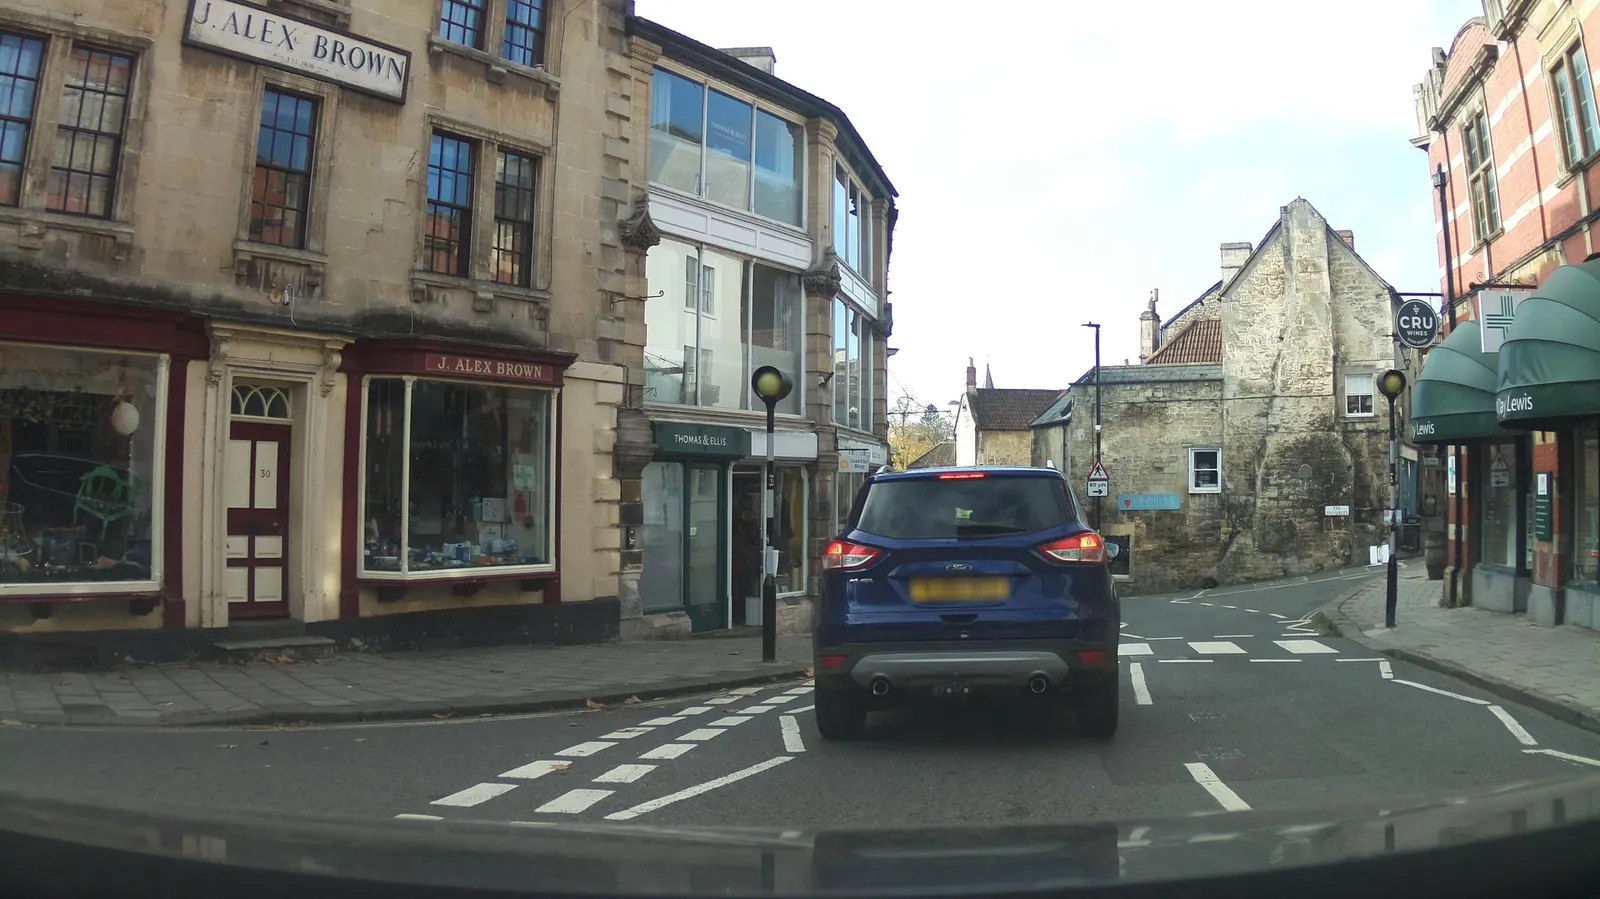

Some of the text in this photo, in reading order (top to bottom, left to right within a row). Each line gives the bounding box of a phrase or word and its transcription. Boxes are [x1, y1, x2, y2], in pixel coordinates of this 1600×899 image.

[194, 2, 405, 82] J. ALEX BROWN
[1400, 316, 1433, 329] CRU
[437, 357, 542, 378] J. ALEX BROWN
[1507, 393, 1533, 412] Lewis
[1416, 420, 1435, 435] Lewis
[674, 434, 701, 445] THOMAS
[710, 436, 727, 446] ELLIS
[260, 469, 271, 478] 30
